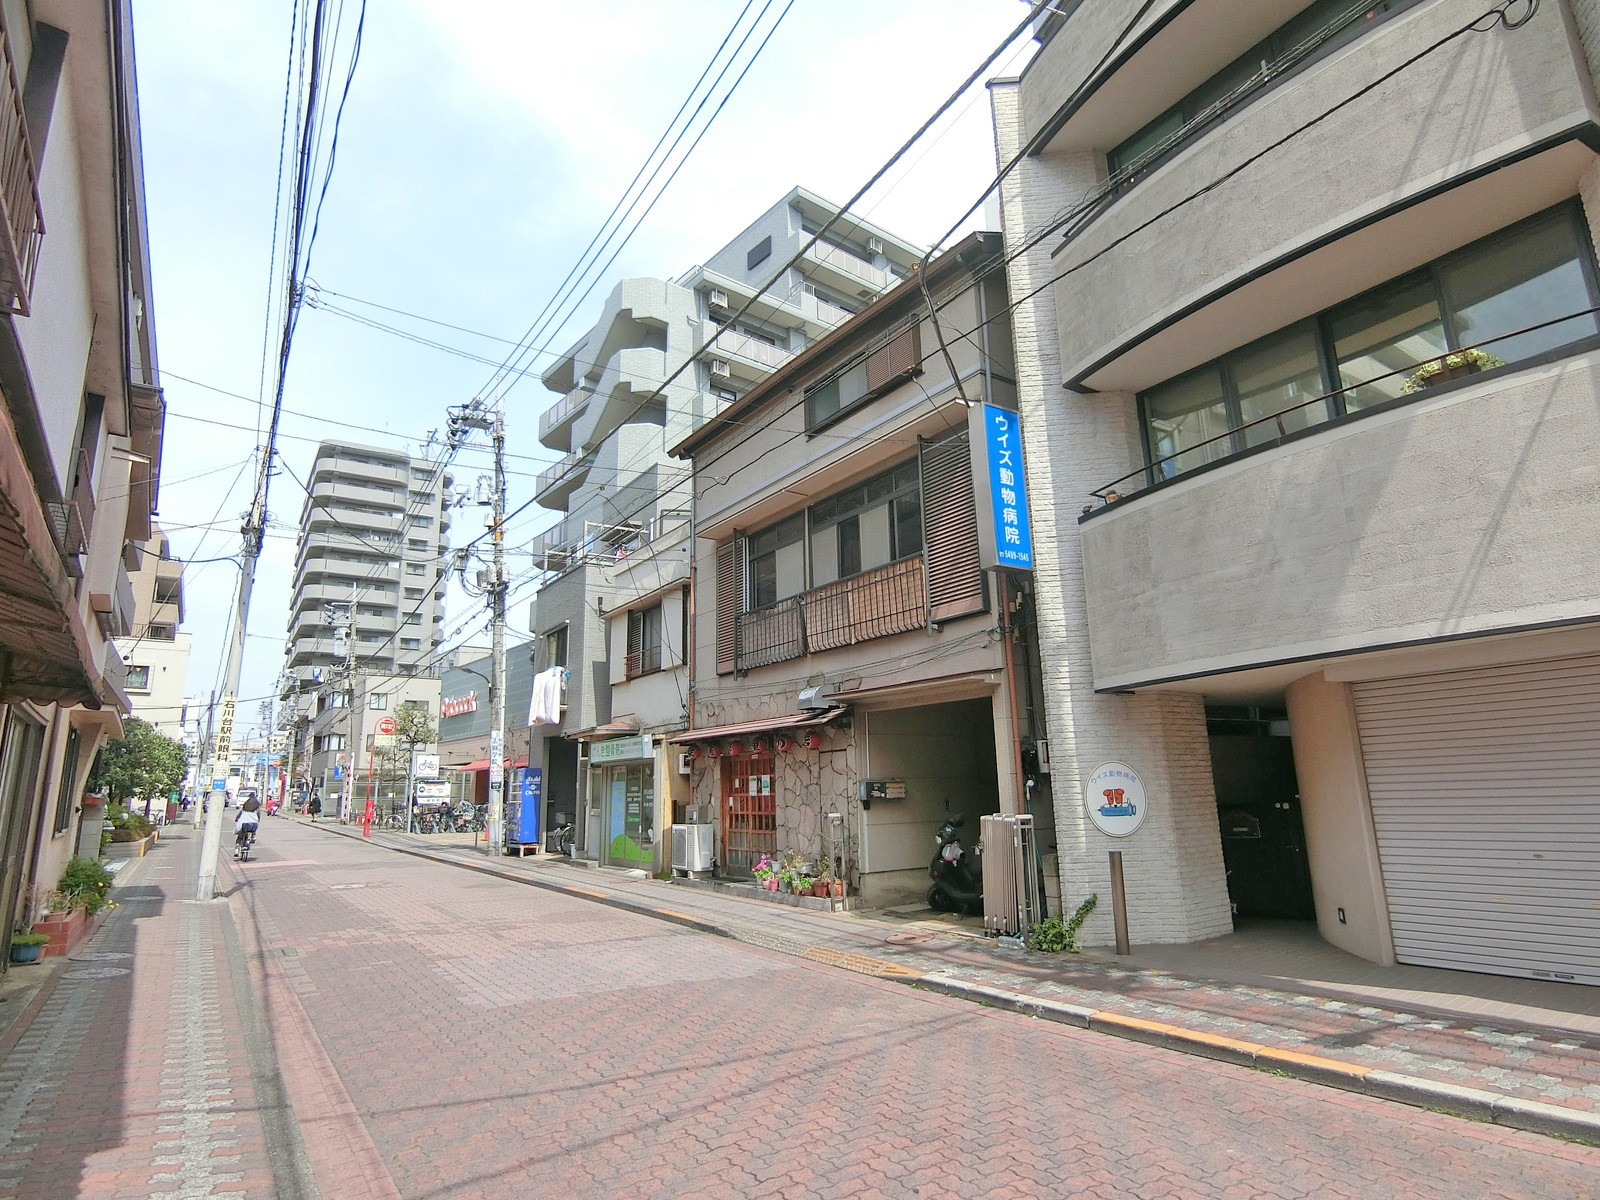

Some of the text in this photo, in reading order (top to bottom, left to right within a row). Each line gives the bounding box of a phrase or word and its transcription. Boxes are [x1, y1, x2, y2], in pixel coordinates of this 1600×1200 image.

[995, 415, 1020, 545] ウイズ動物病院
[217, 700, 235, 762] 石川台駅前眼科
[1090, 770, 1137, 784] ウイズ動物病院
